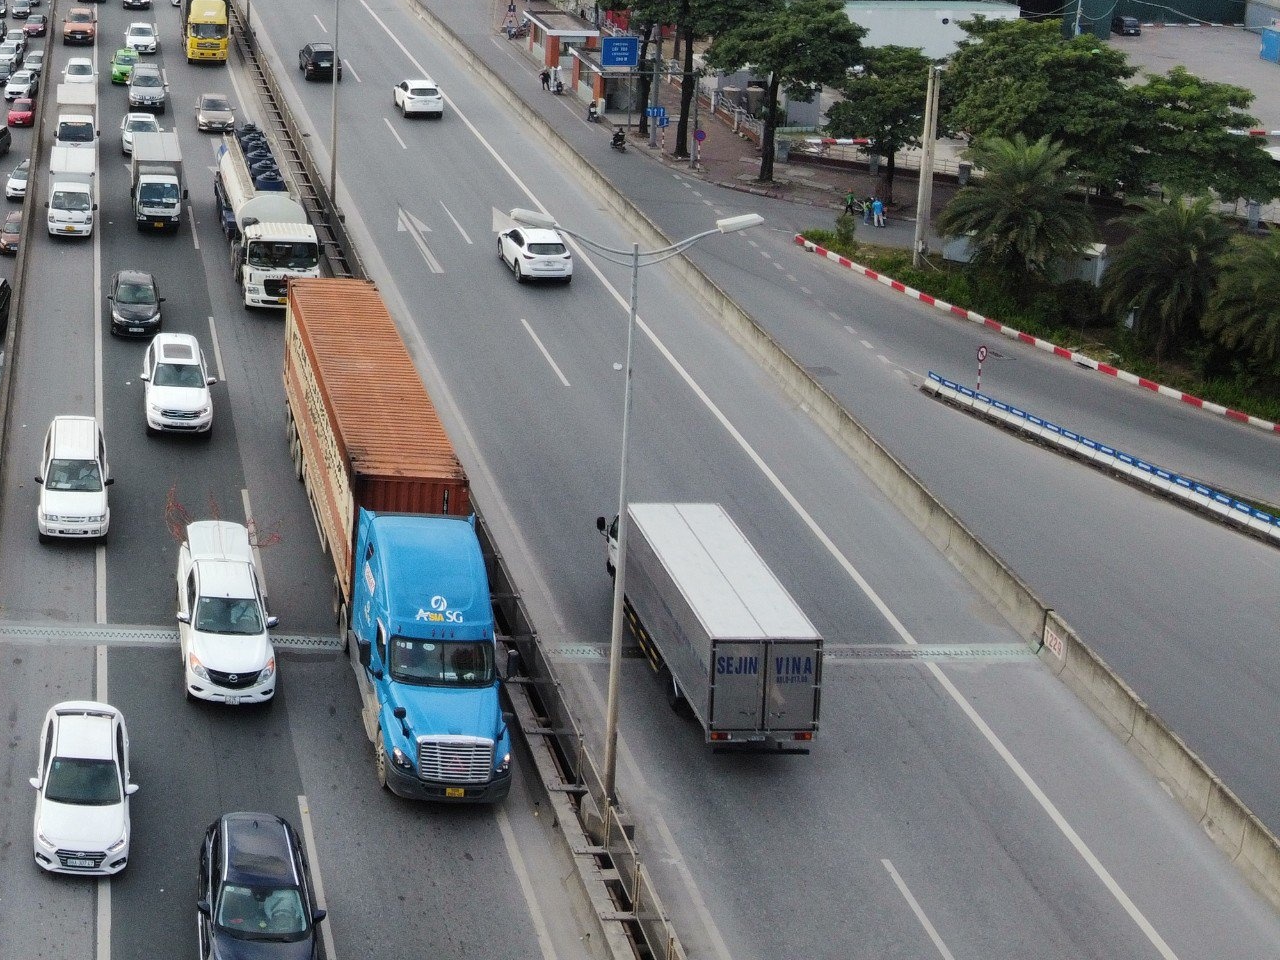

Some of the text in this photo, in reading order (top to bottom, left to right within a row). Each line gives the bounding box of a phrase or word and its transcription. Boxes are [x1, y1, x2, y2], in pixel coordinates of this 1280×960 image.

[446, 610, 463, 623] SG
[717, 656, 812, 675] SEJIN VINA
